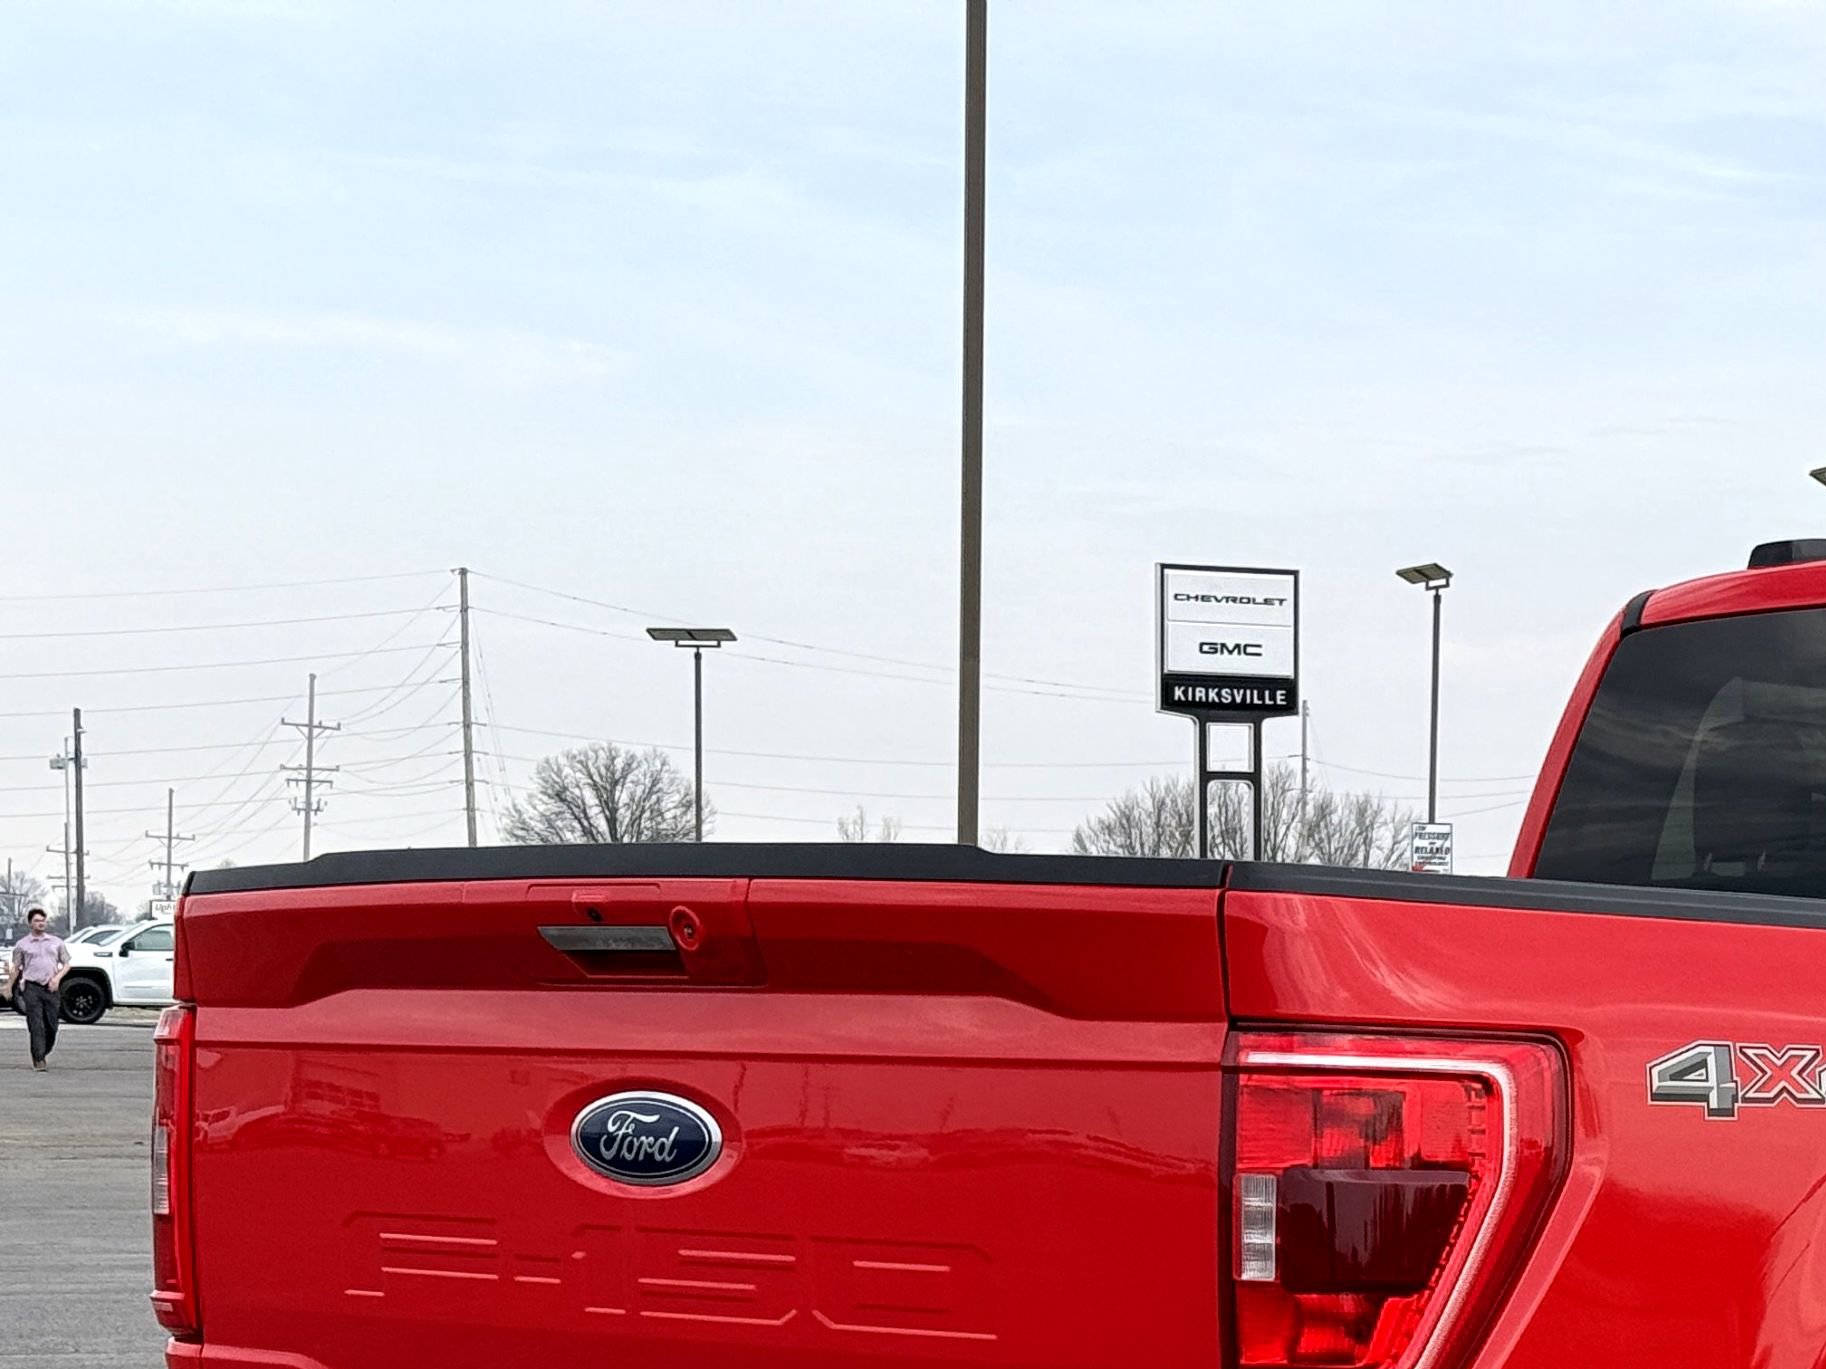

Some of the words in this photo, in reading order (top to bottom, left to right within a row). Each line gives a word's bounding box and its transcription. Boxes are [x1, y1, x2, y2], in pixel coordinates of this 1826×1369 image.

[1174, 593, 1287, 606] CHEVROLET
[1199, 642, 1263, 656] GMC
[1174, 686, 1287, 705] KIRKSVILLE
[600, 1110, 680, 1163] Ford
